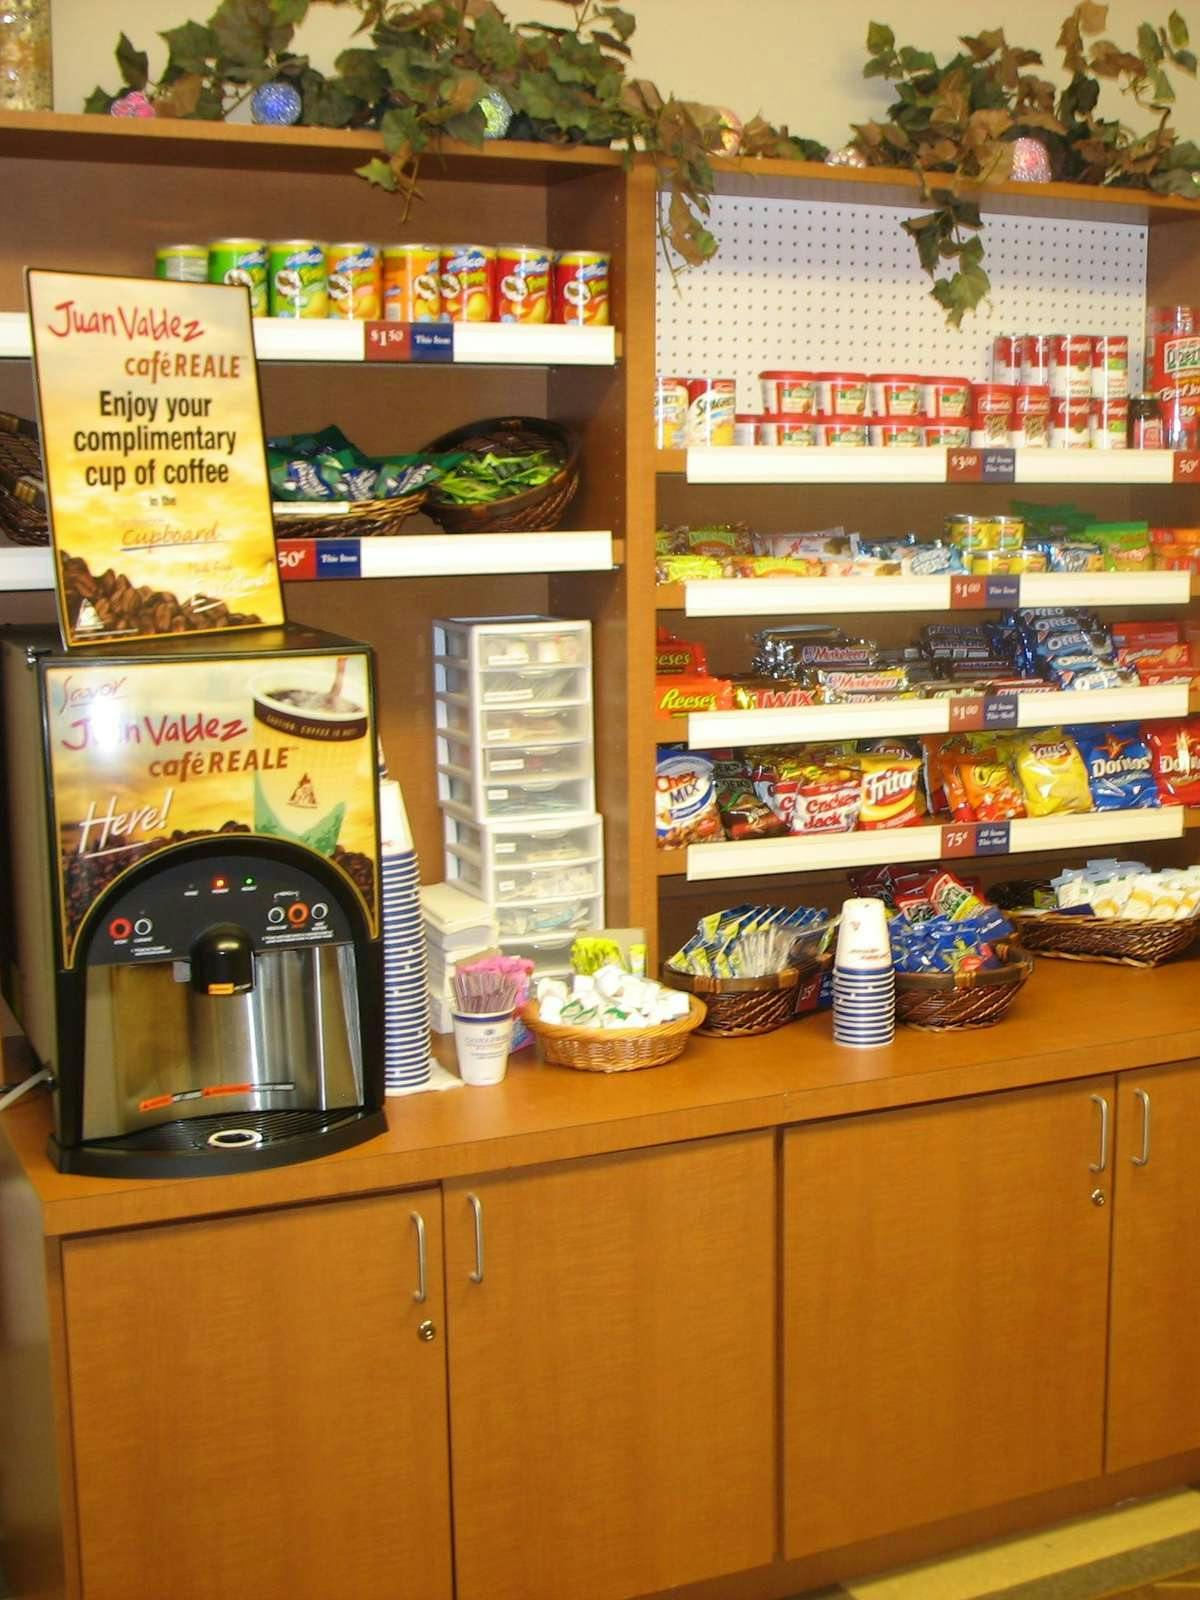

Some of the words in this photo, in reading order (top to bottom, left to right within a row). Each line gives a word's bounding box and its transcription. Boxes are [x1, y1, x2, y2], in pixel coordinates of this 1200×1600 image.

[49, 301, 115, 337] Juan
[117, 305, 205, 342] Valdez
[100, 390, 158, 423] Enjoy
[166, 394, 212, 422] your
[74, 427, 237, 458] complimentary
[85, 463, 126, 492] cup
[135, 459, 156, 485] of
[163, 460, 230, 485] coffee
[1047, 632, 1085, 650] ORE
[659, 687, 717, 711] Reese's
[755, 688, 816, 708] TWIX
[61, 718, 141, 750] Jn
[144, 712, 248, 746] Valdez
[1091, 755, 1151, 778] Doritos
[79, 787, 175, 855] Here!
[804, 812, 842, 828] Jack
